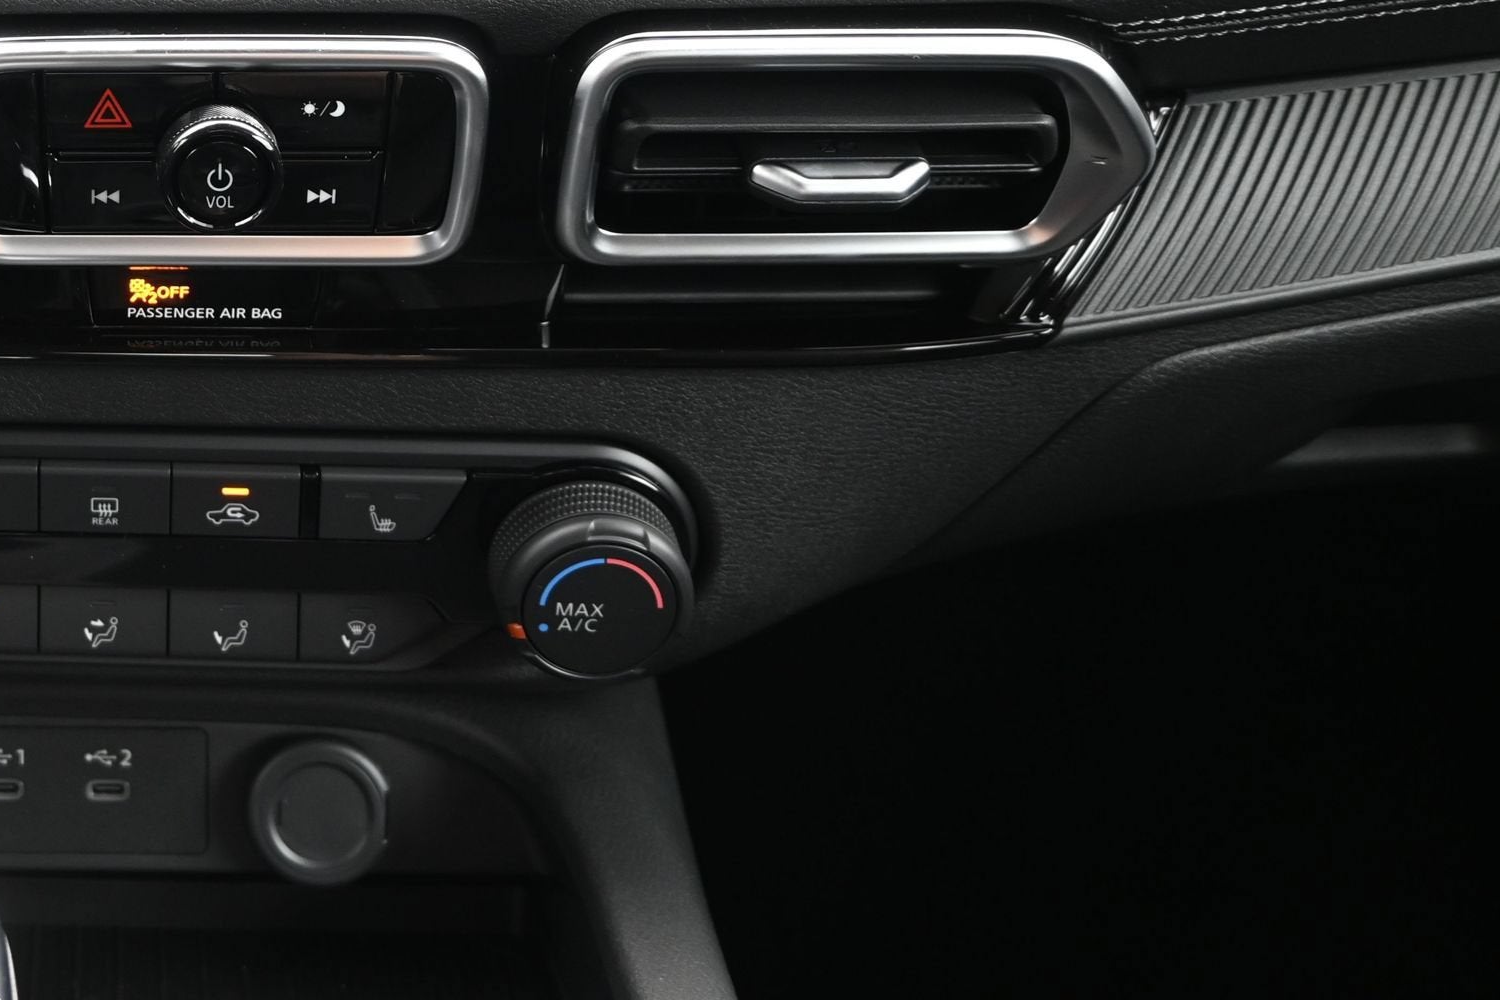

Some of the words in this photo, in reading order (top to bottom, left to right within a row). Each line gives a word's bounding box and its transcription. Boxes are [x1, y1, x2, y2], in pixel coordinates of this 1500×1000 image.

[206, 195, 234, 209] VOL
[157, 286, 190, 299] OFF
[127, 307, 215, 319] PASSENGER
[219, 307, 246, 319] AIR
[251, 307, 283, 319] BAG
[91, 516, 119, 526] REAR
[555, 602, 604, 617] MAX
[557, 617, 598, 633] A/C
[16, 748, 26, 766] 1
[119, 748, 132, 767] 2
